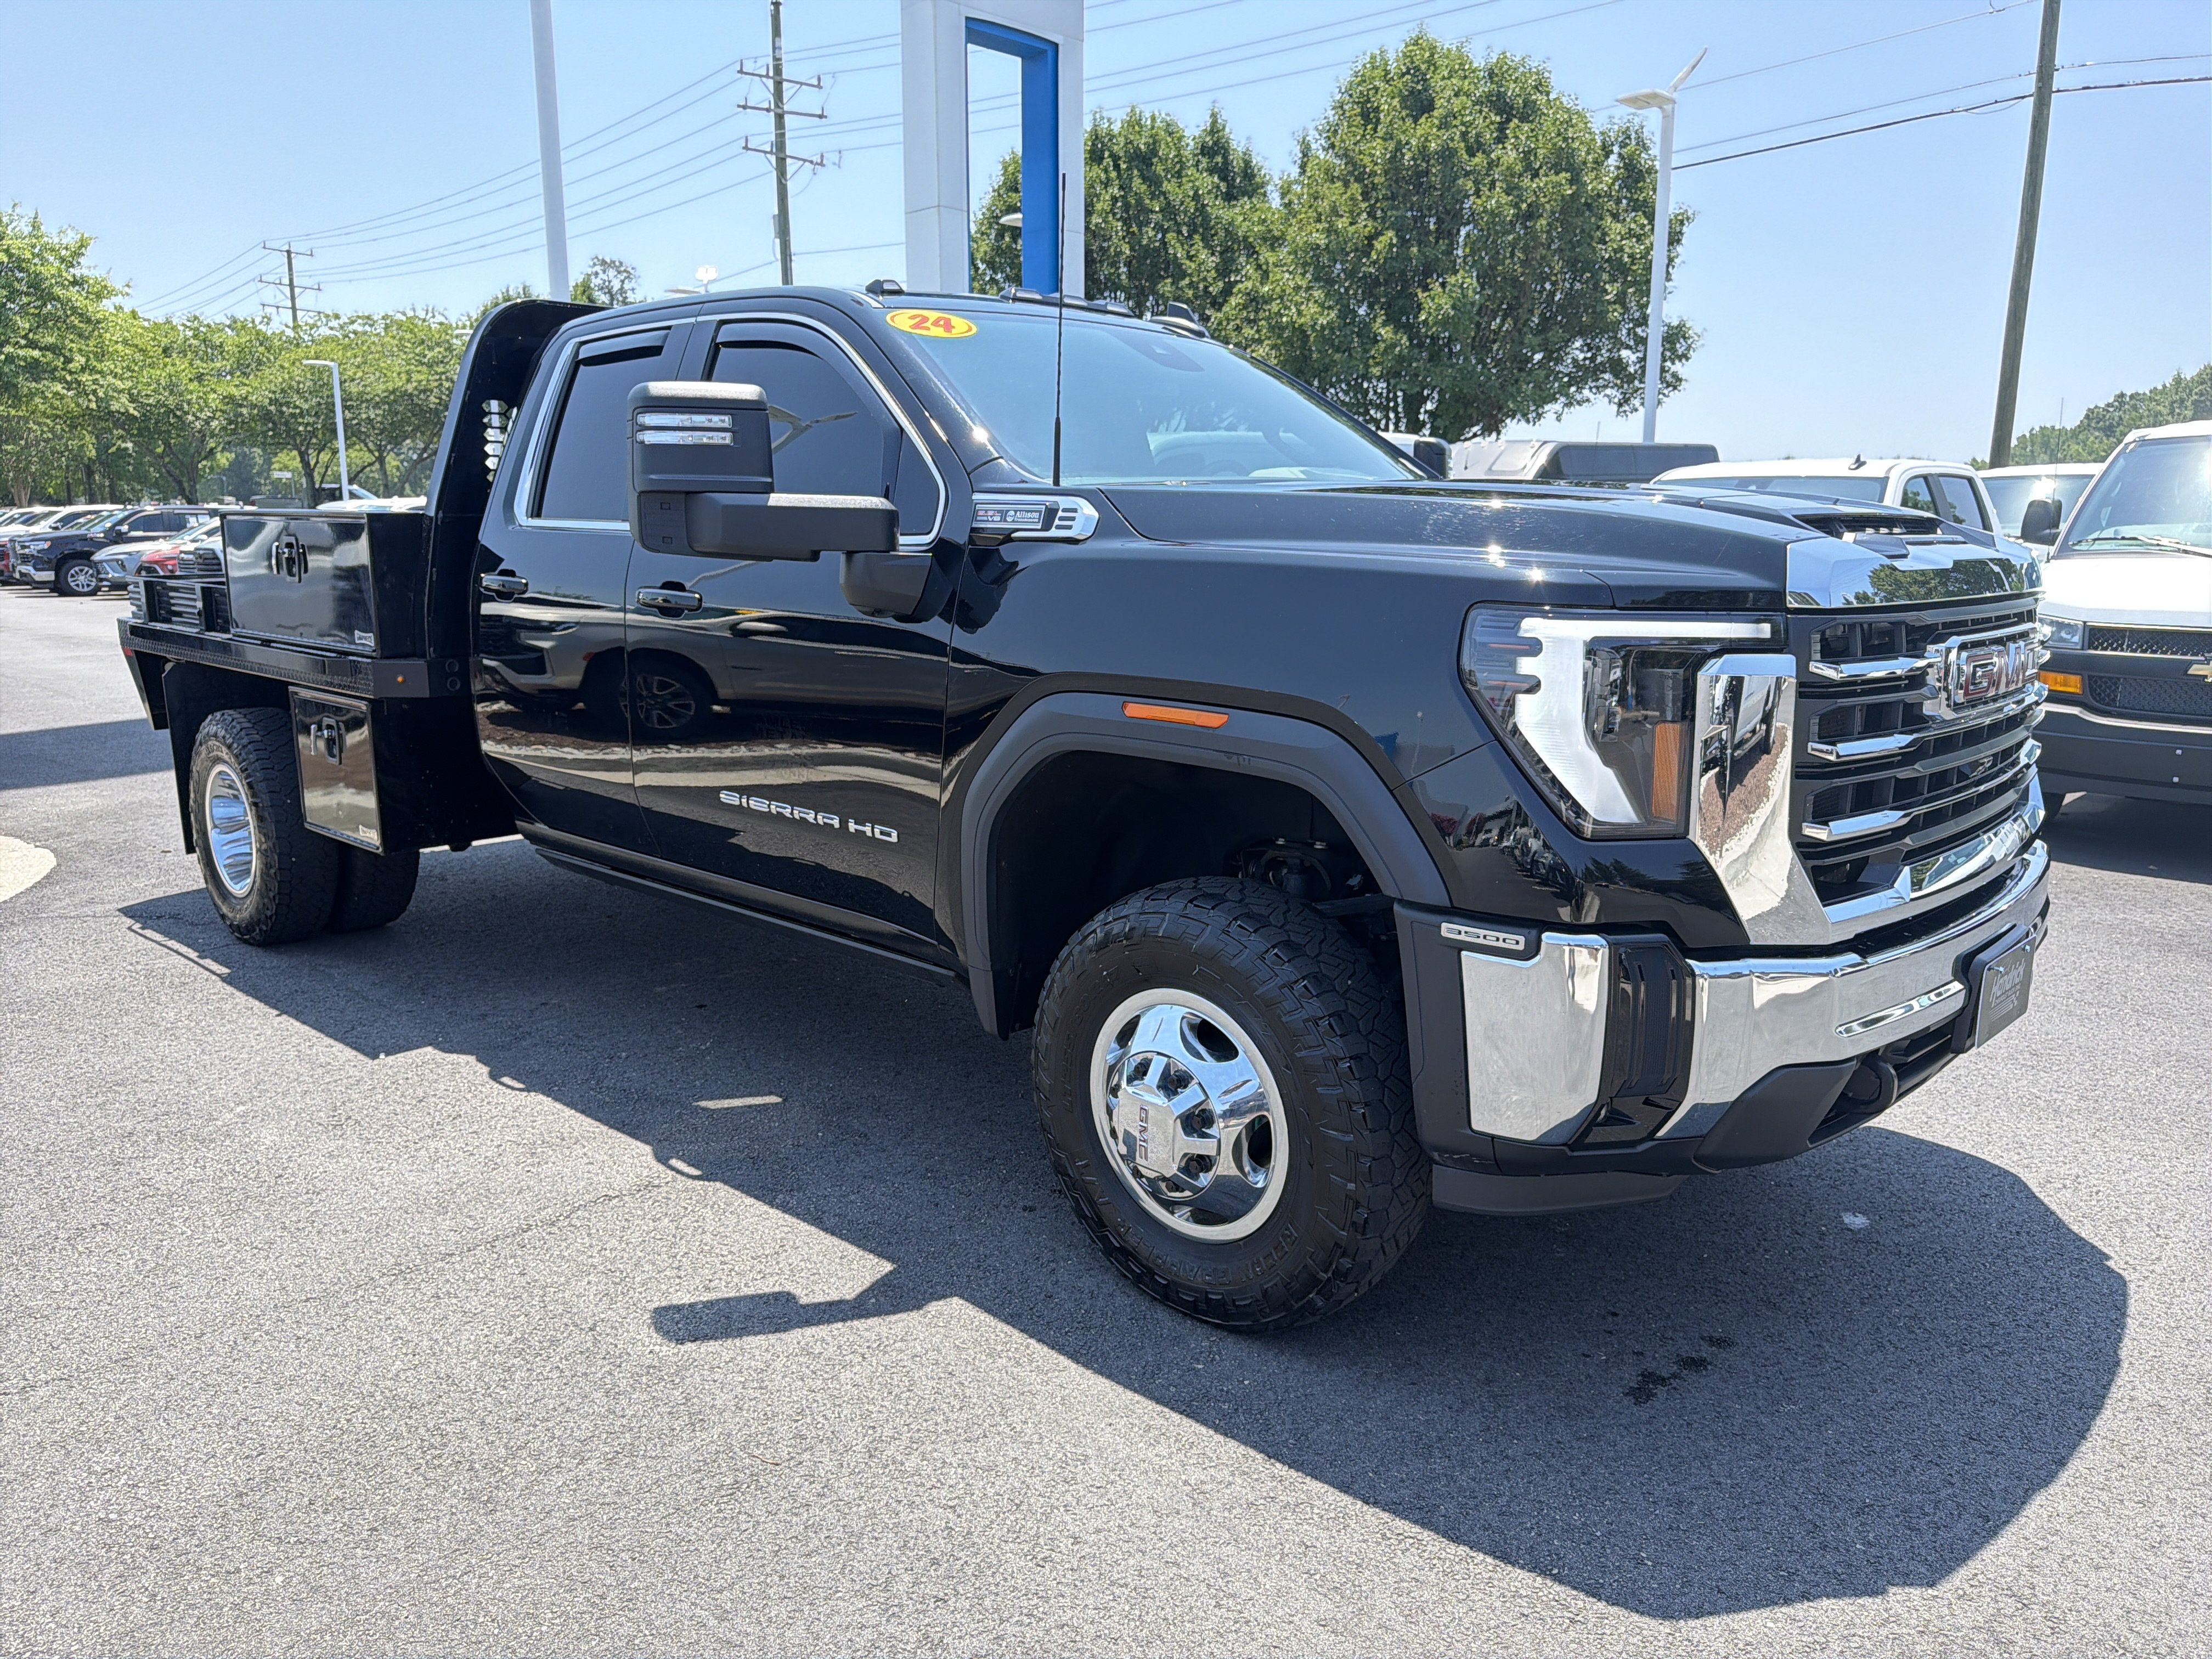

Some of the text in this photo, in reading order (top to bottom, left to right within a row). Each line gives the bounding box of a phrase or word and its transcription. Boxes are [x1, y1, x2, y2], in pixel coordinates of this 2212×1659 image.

[909, 314, 955, 333] 24
[1959, 639, 2039, 703] GMC
[719, 790, 899, 843] SIERRA HD
[1445, 927, 1520, 946] 3500
[1138, 1104, 1149, 1161] GMC
